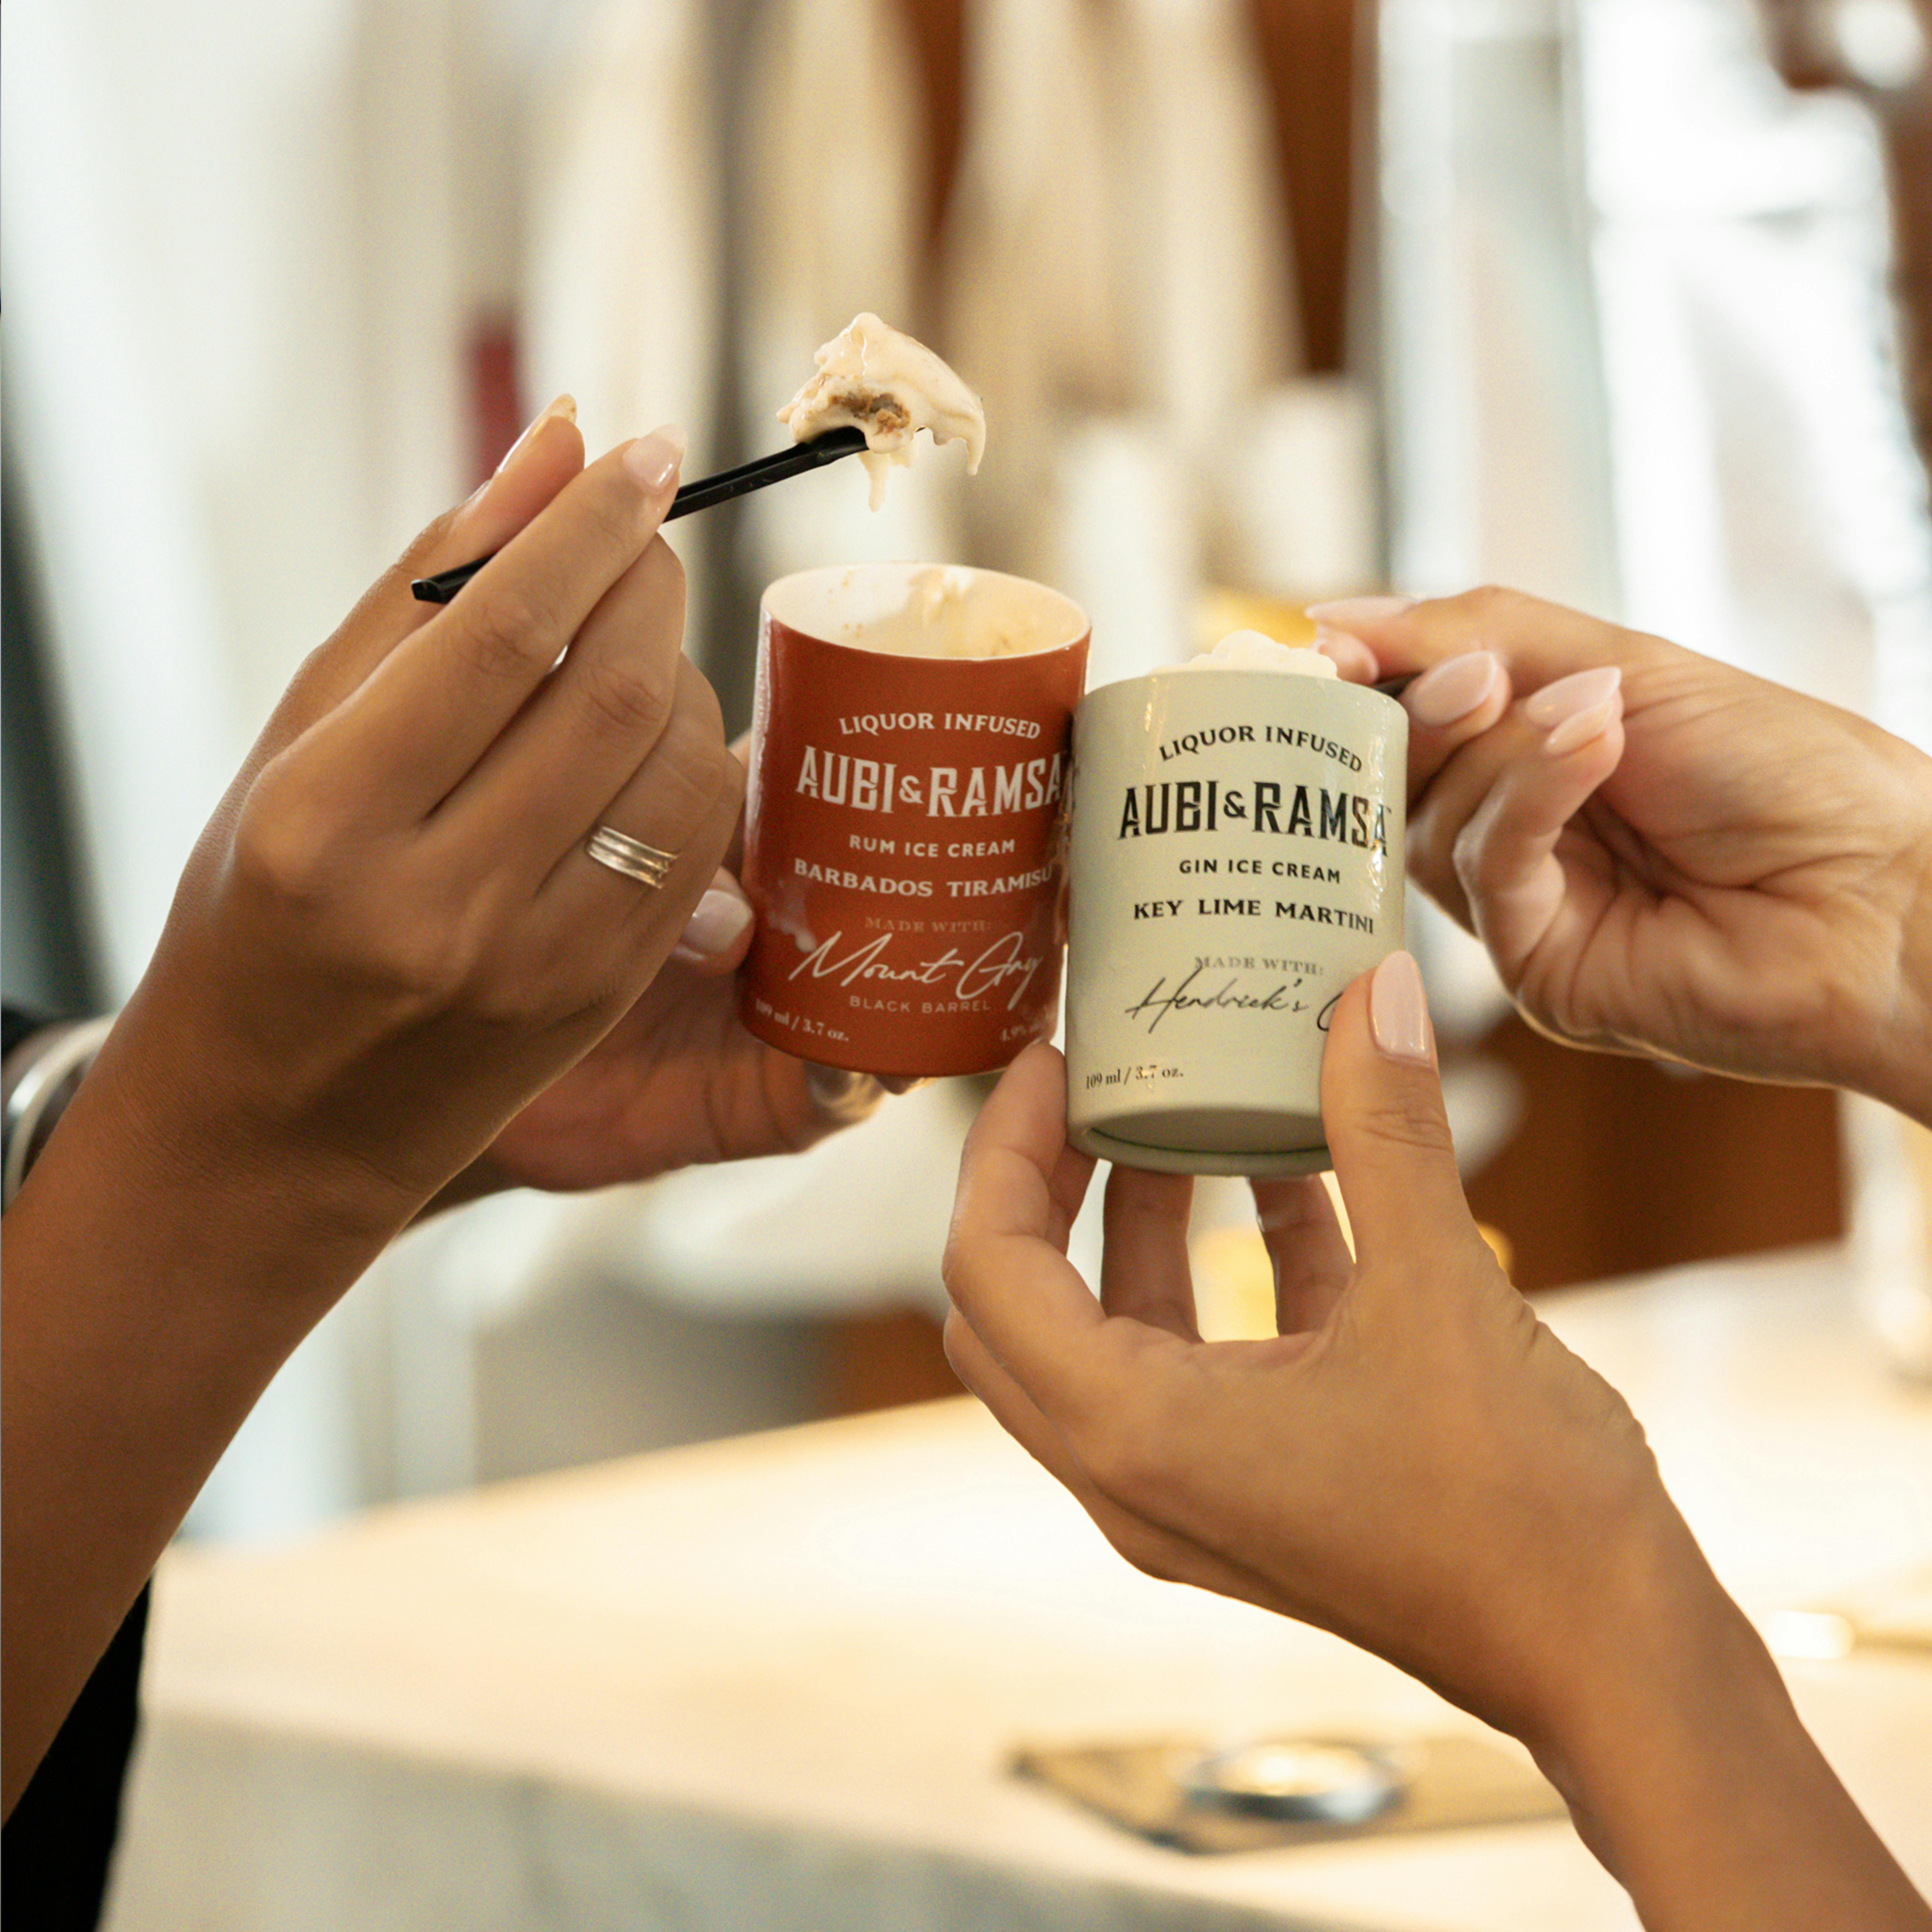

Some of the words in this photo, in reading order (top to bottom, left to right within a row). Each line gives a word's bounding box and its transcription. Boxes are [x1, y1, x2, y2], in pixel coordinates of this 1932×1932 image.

[839, 712, 934, 736] LIQUOR
[944, 713, 1040, 740] INFUSED
[1159, 725, 1255, 762] LIQUOR
[1266, 726, 1362, 773] INFUSED
[849, 835, 895, 854] RUM
[905, 842, 938, 857] ICE
[947, 839, 1015, 857] CREAM
[794, 857, 933, 897] BARBADOS
[947, 865, 1053, 897] TIRAMISU
[1180, 859, 1218, 874] GIN
[1228, 859, 1262, 875] ICE
[1272, 860, 1341, 884] CREAM
[865, 917, 925, 932] MADE
[1134, 900, 1184, 920] KEY
[1198, 898, 1261, 916] LIME
[1275, 901, 1374, 934] MARTINI
[788, 931, 964, 986] Mount
[1194, 956, 1255, 969] MADE
[1262, 958, 1323, 976] WITH:
[850, 995, 911, 1013] BLACK
[922, 999, 990, 1014] BARREL
[1125, 966, 1309, 1034] Hendrick's
[774, 1011, 790, 1026] ml
[803, 1018, 825, 1036] 3.7
[827, 1029, 849, 1042] oz.
[1086, 1072, 1102, 1090] 109
[1106, 1068, 1120, 1084] ml
[1135, 1065, 1157, 1080] 3.7
[1161, 1068, 1184, 1078] oz.
